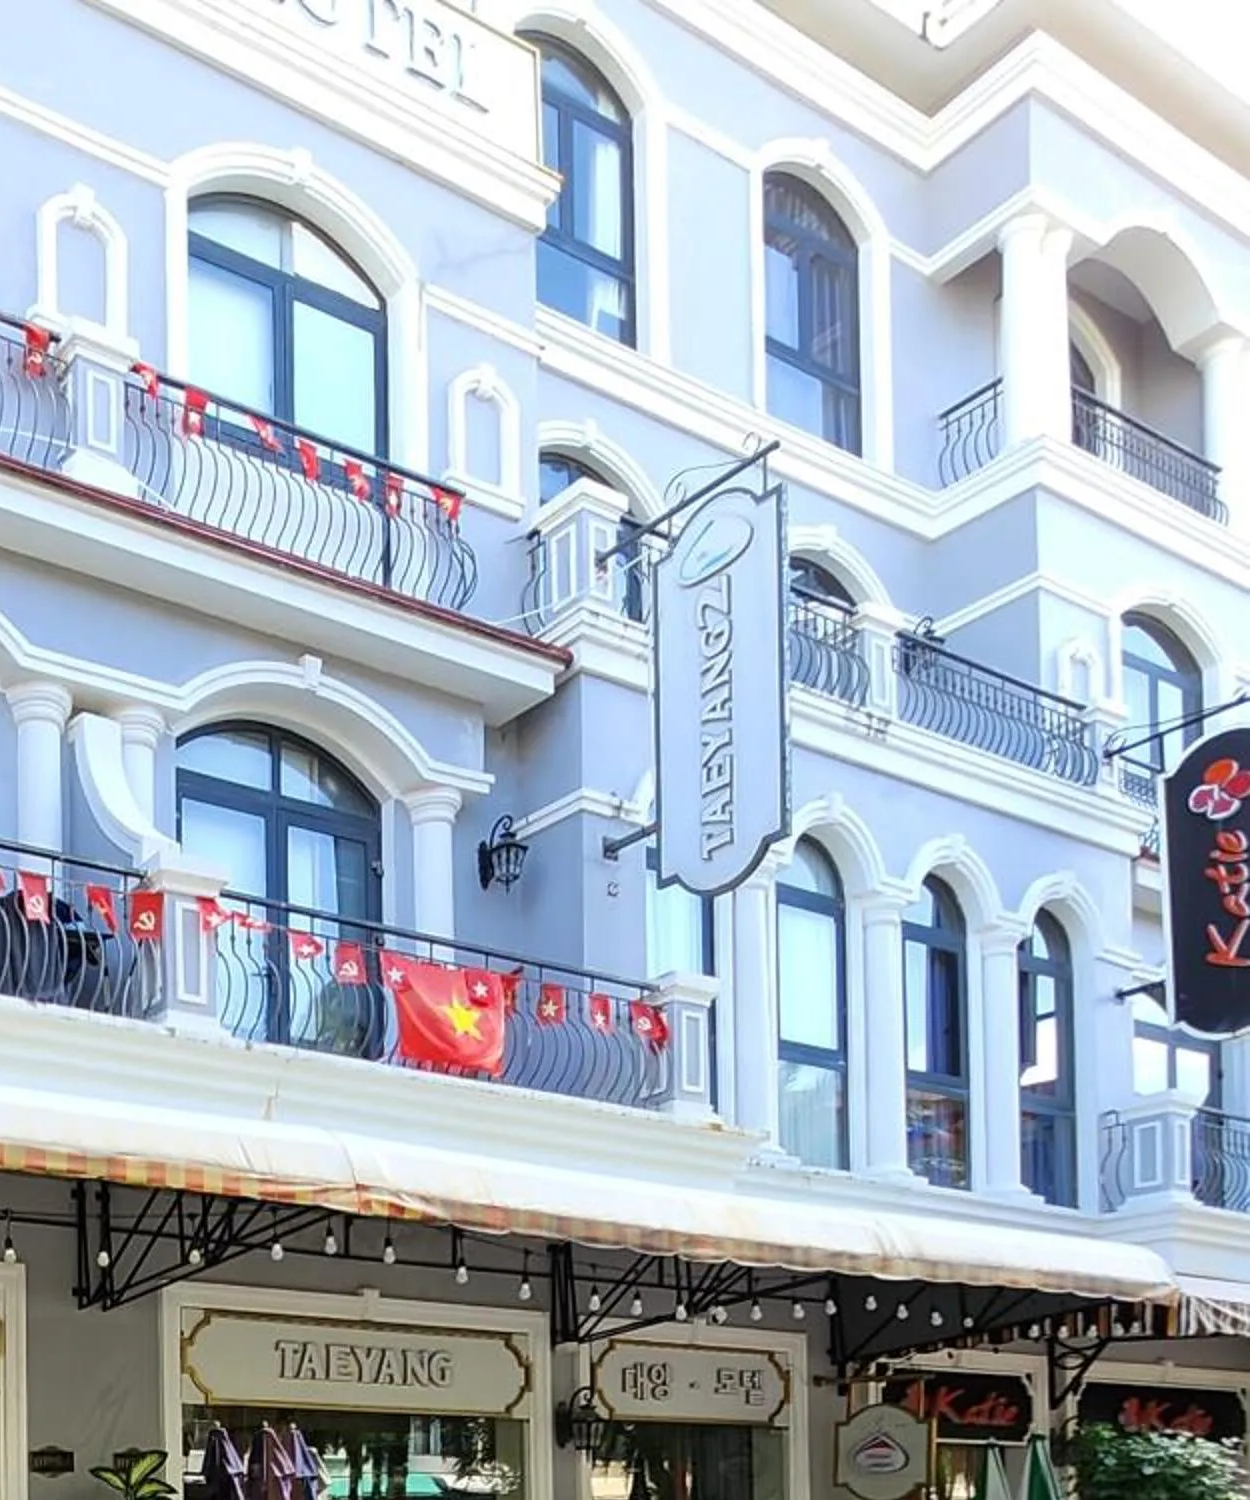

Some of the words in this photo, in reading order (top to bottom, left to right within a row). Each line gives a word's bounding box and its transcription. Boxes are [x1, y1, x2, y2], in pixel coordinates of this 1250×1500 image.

[1204, 829, 1250, 967] Katie
[274, 1340, 453, 1388] TAEYANG
[933, 1386, 1021, 1427] Katie
